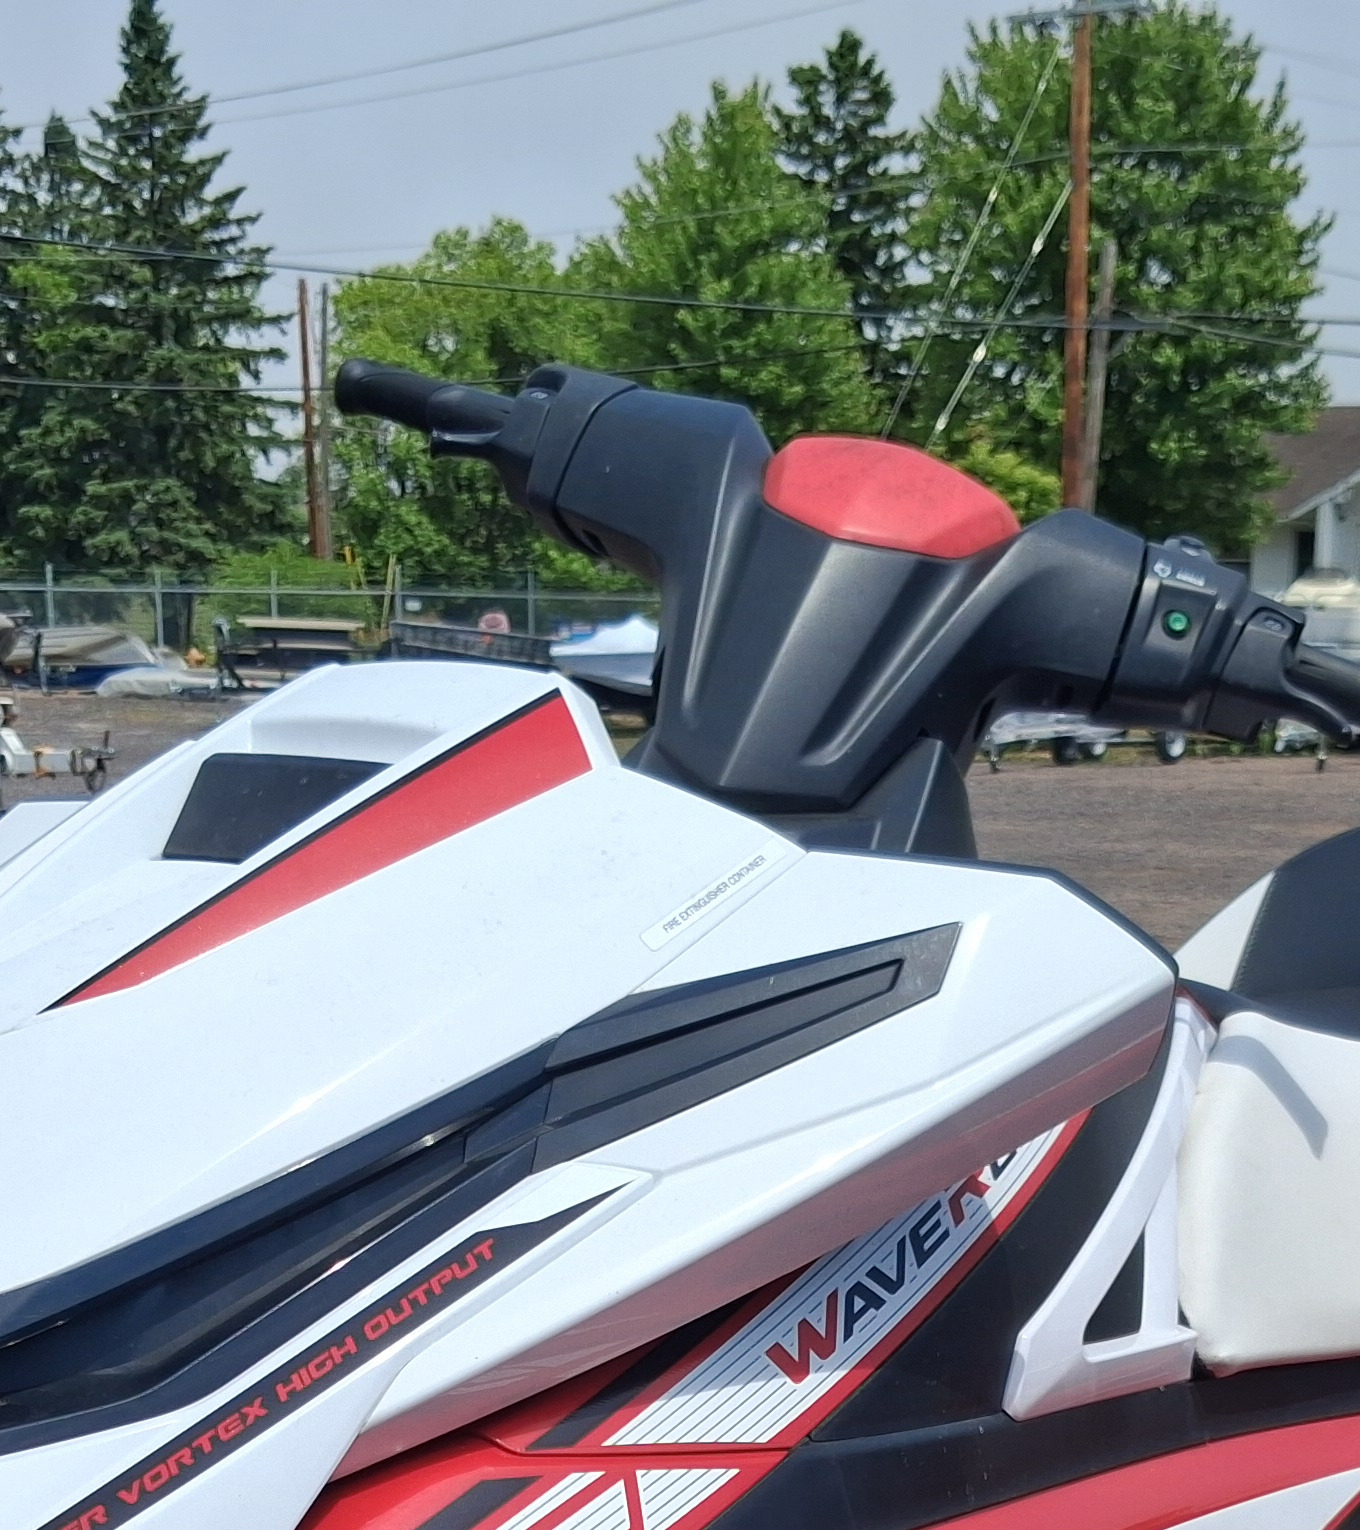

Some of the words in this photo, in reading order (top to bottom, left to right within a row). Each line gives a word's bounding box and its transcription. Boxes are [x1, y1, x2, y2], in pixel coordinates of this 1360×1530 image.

[662, 916, 682, 933] FIRE
[678, 881, 731, 921] EXTINGUISHER
[727, 854, 767, 886] CONTAINER
[116, 1397, 270, 1507] VORTEX
[273, 1336, 359, 1402] HIGH
[363, 1237, 497, 1342] OUTPUT
